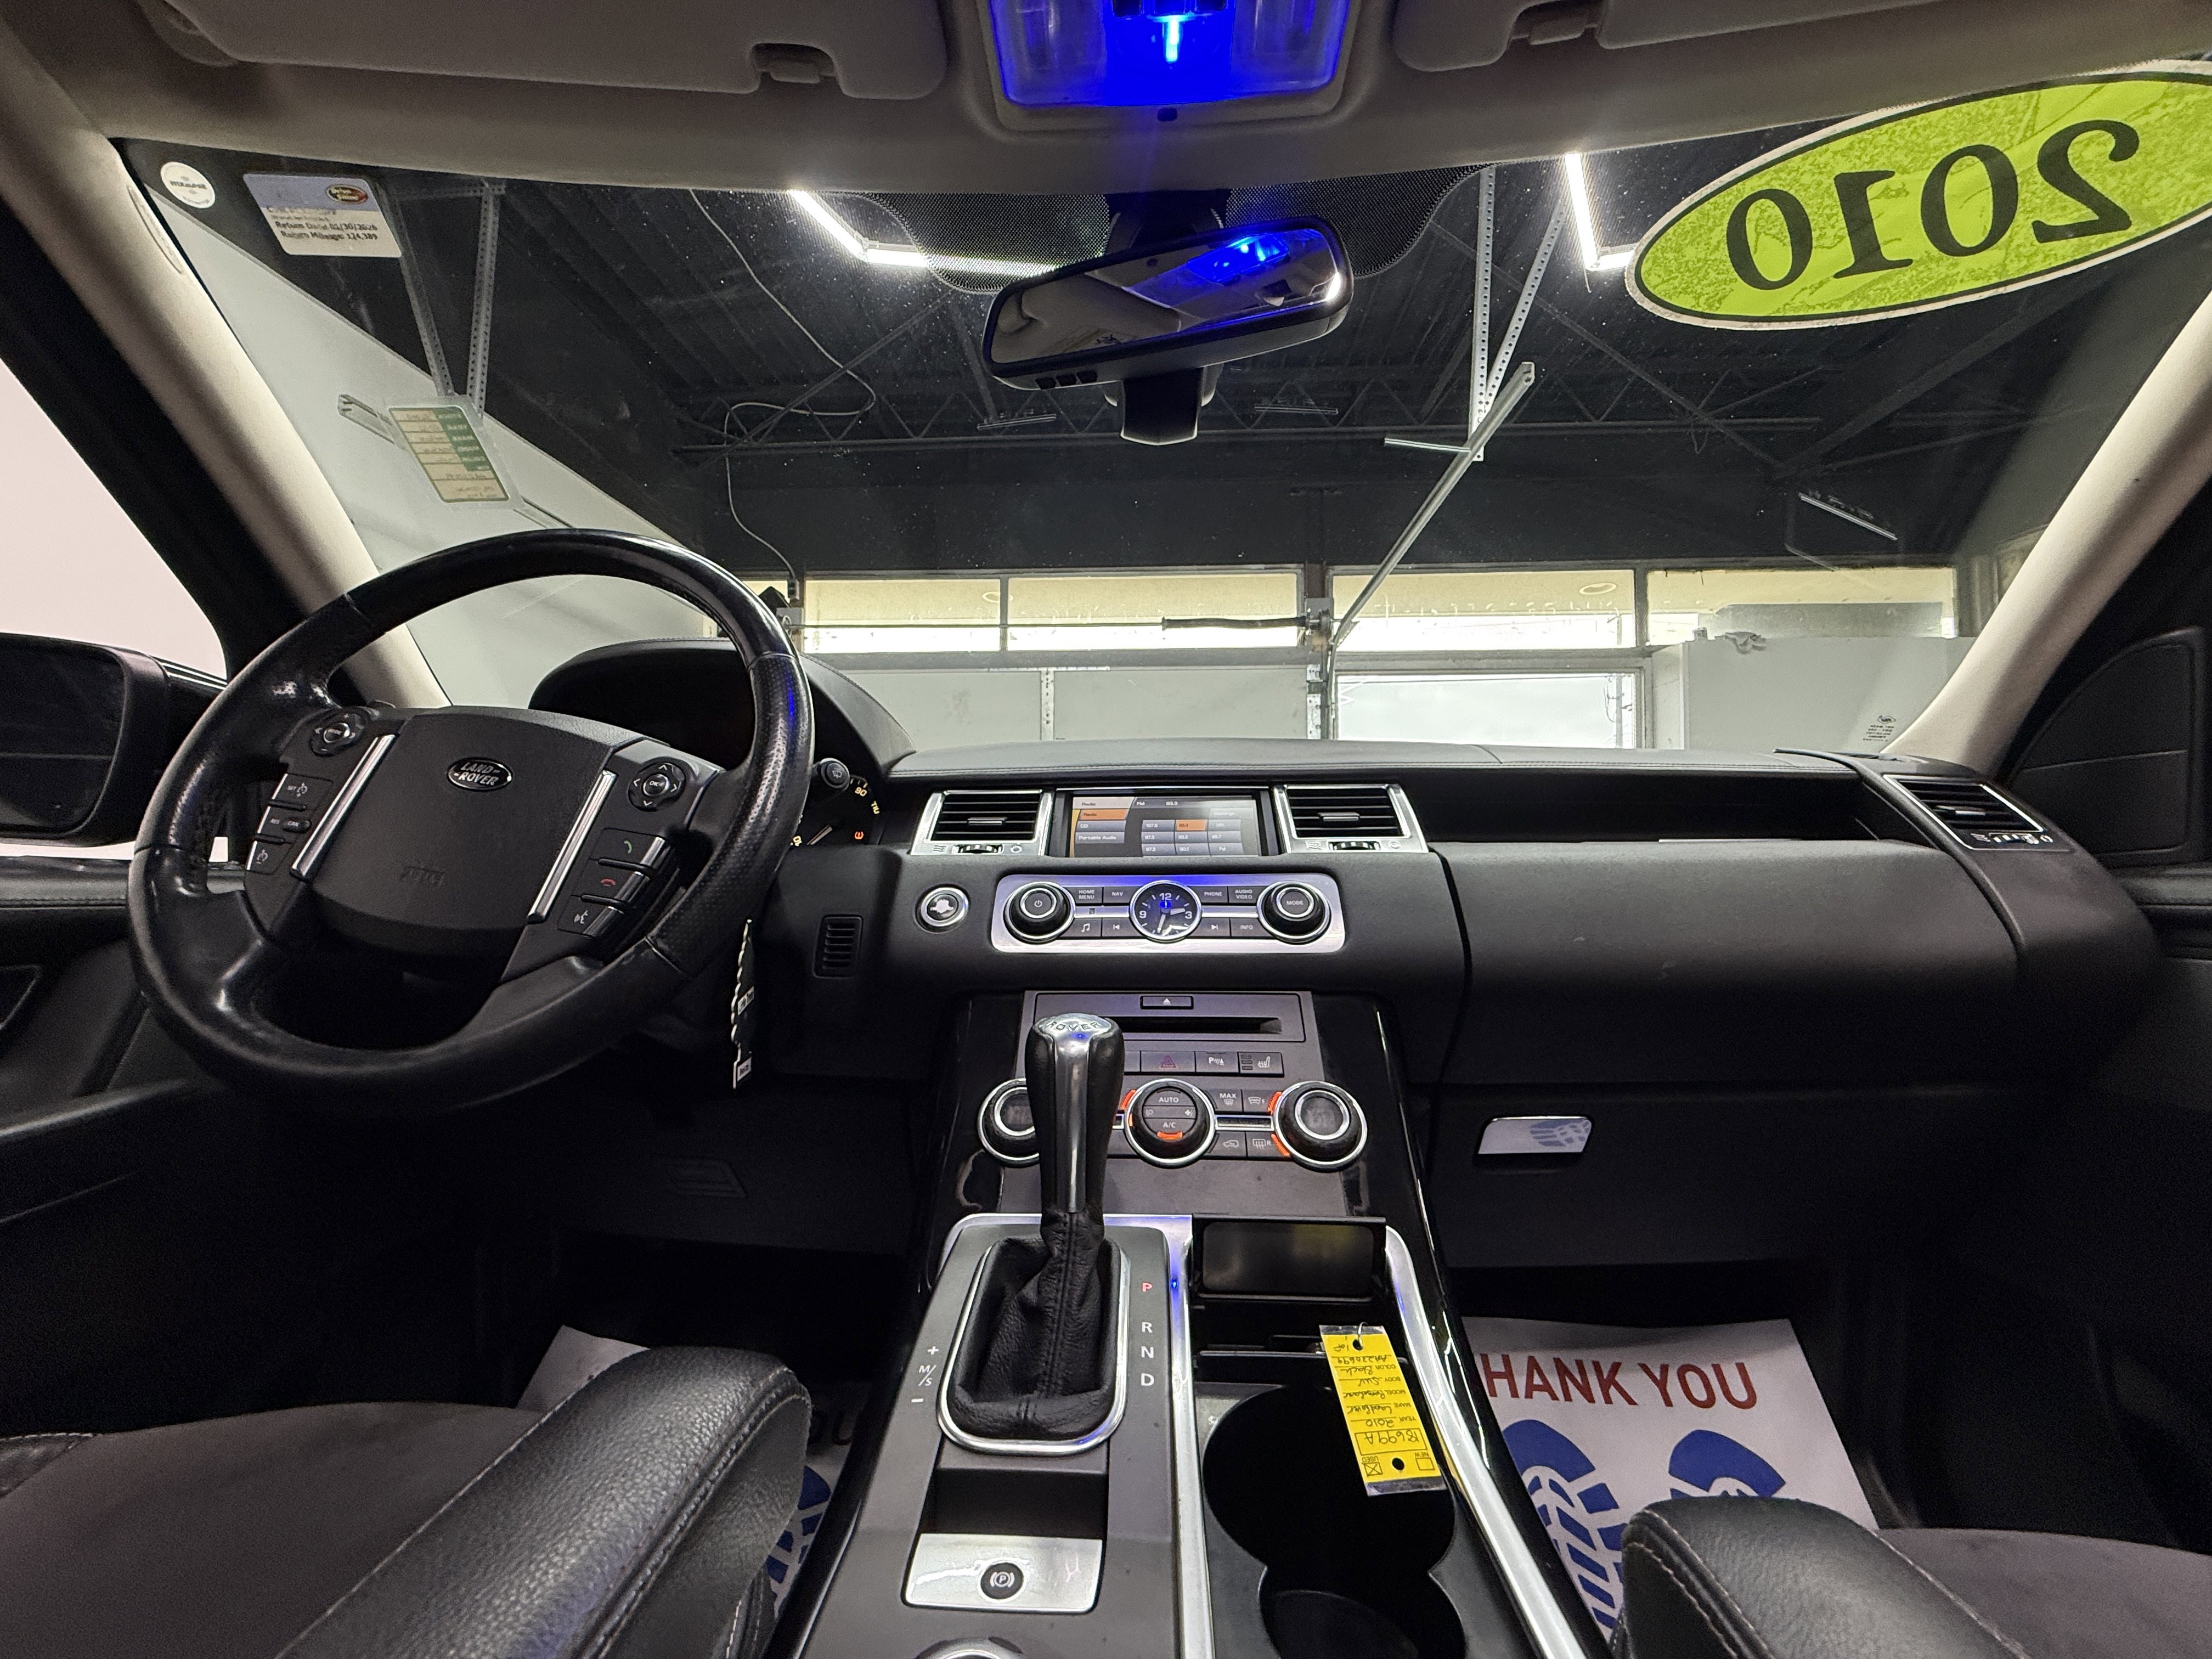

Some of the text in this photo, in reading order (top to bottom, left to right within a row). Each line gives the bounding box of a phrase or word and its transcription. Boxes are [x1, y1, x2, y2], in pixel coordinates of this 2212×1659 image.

[855, 787, 867, 797] 90
[1160, 893, 1172, 901] 12
[1139, 910, 1147, 919] 9
[1185, 911, 1193, 919] 3
[1142, 1282, 1153, 1293] P
[1141, 1322, 1153, 1333] R
[1141, 1346, 1154, 1359] N
[1141, 1373, 1155, 1386] D
[1480, 1352, 1758, 1410] HANK YOU
[1365, 1419, 1395, 1428] 2010
[1362, 1455, 1379, 1463] USED
